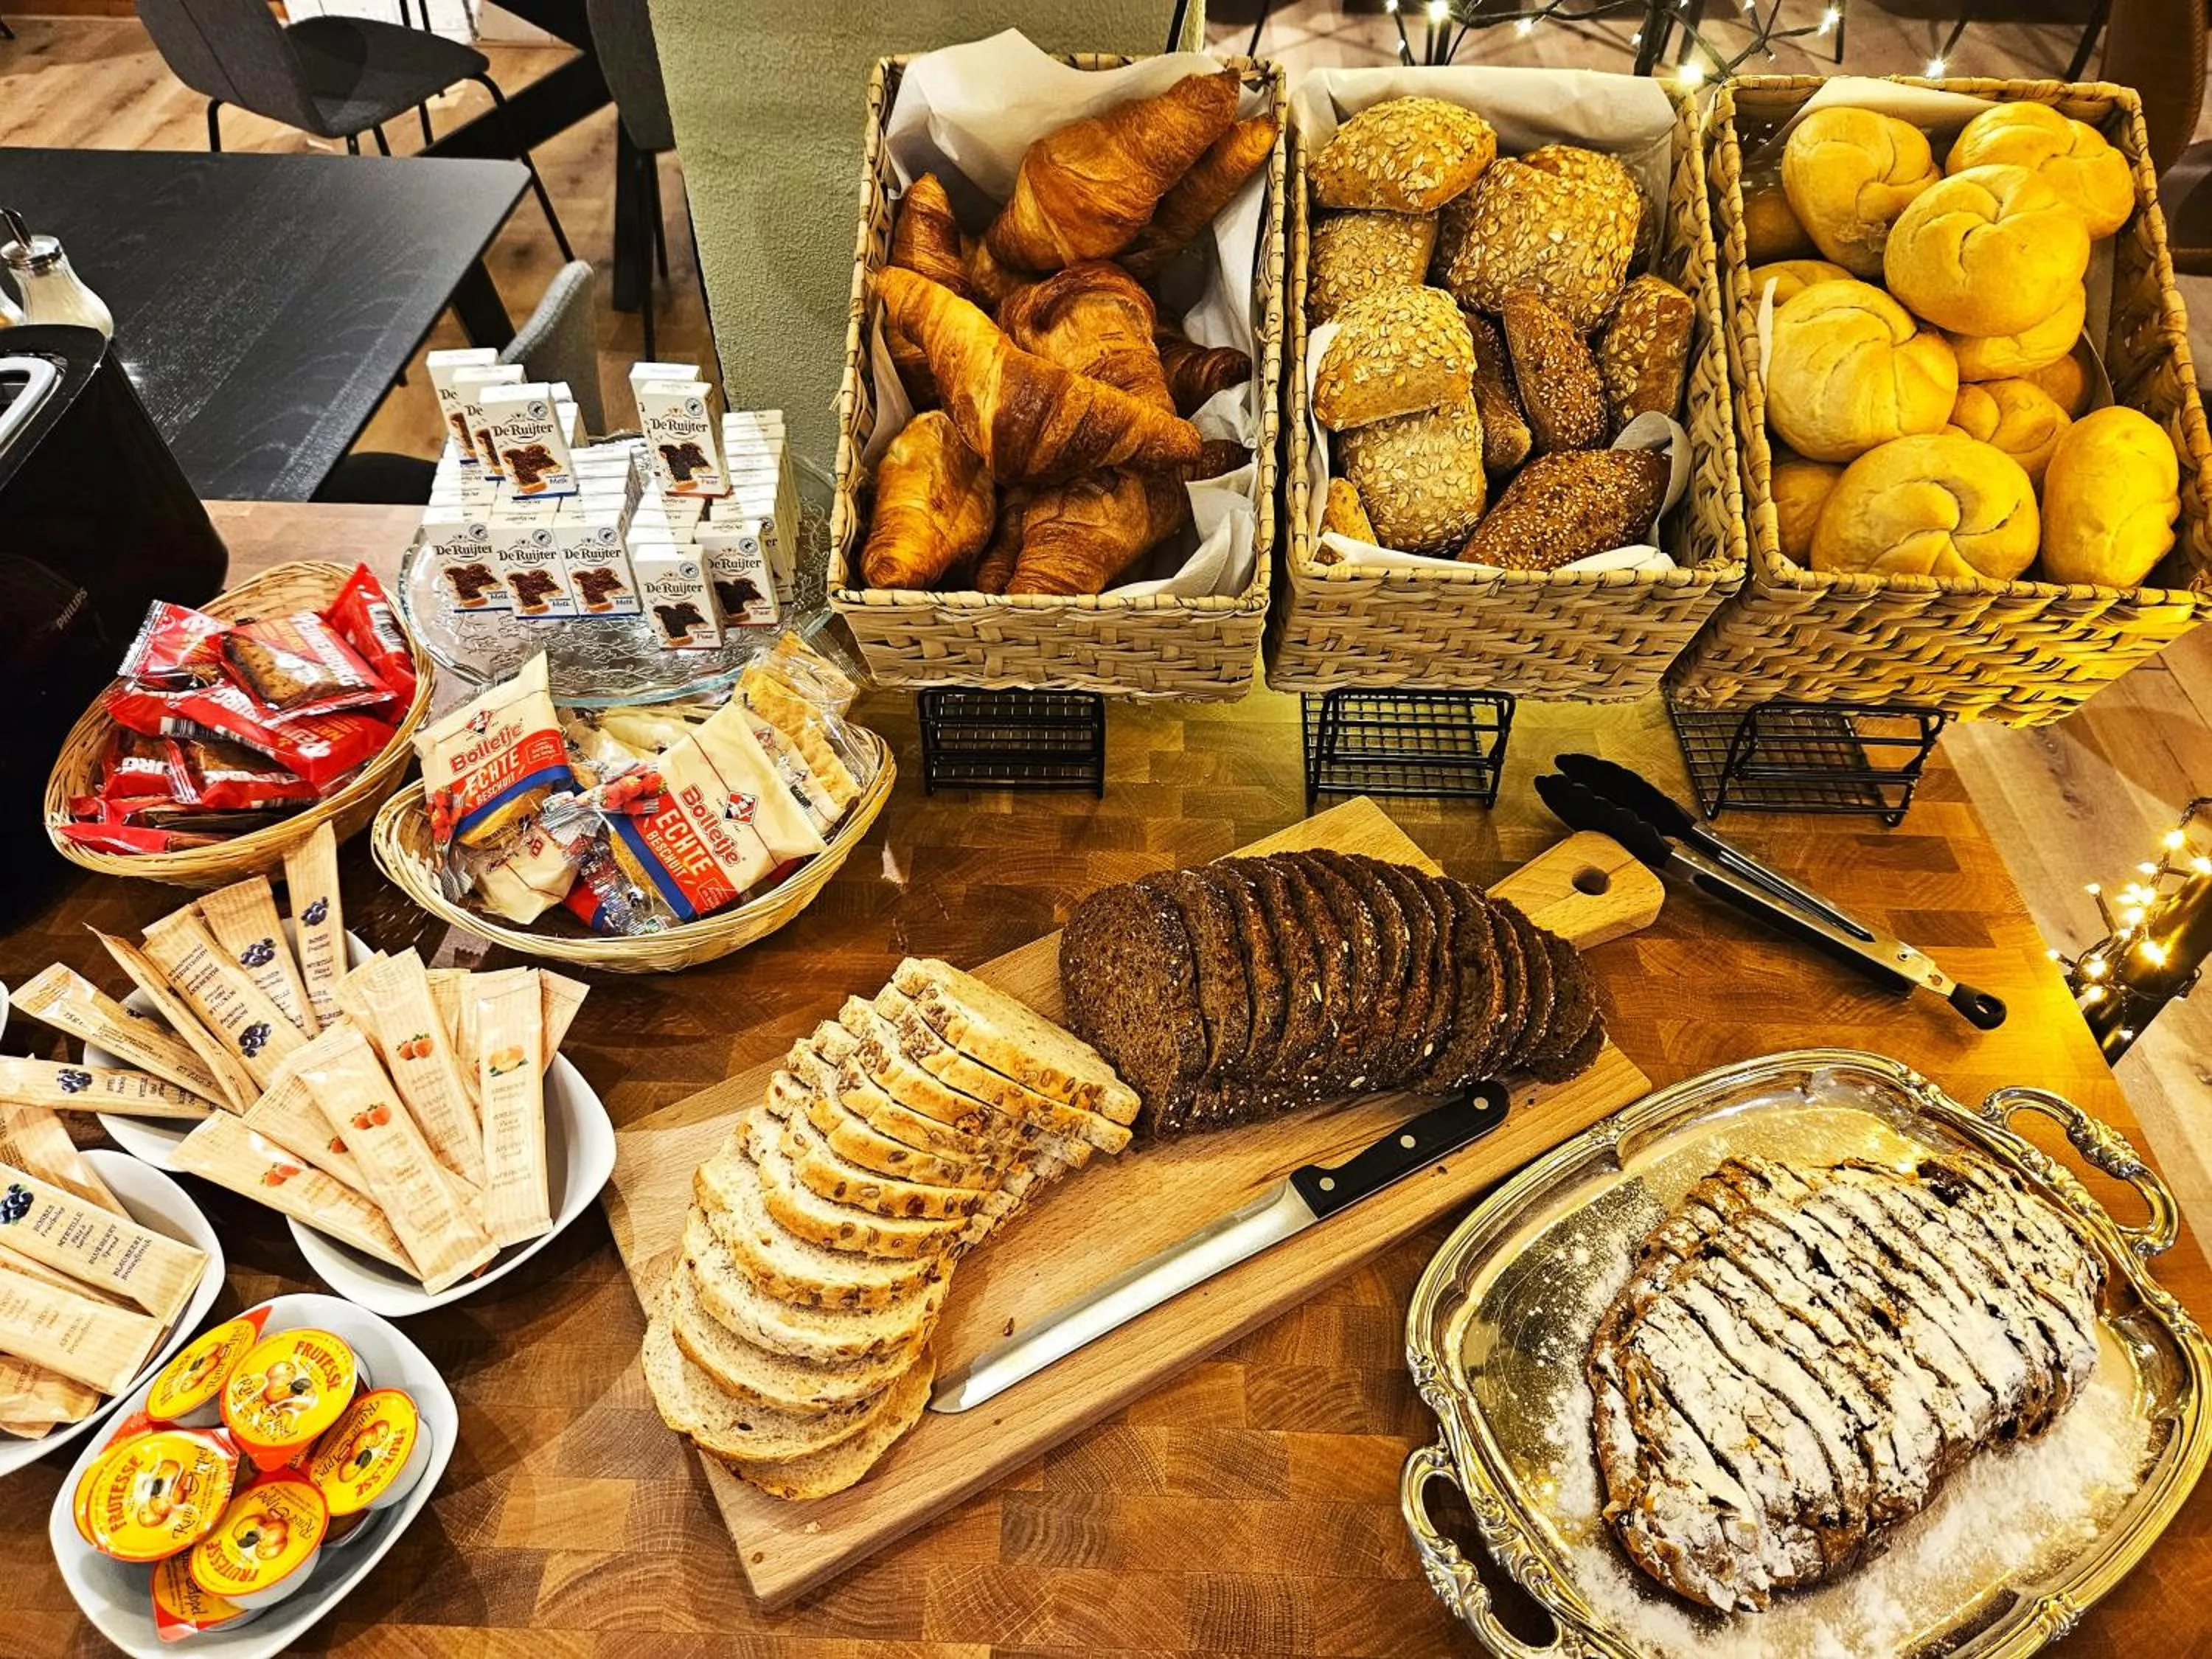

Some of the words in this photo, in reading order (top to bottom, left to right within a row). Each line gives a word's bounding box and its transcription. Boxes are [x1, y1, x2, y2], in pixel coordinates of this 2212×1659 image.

[491, 425, 511, 437] De
[511, 423, 554, 439] Ruijter
[650, 418, 667, 430] De
[668, 418, 708, 434] Ruijter
[434, 545, 451, 554] De
[498, 550, 515, 561] De
[515, 550, 556, 565] Ruijter
[563, 549, 580, 559] De
[581, 548, 622, 563] Ruijter
[722, 558, 762, 572] Ruijter
[56, 588, 88, 629] PHILIPS
[644, 583, 661, 593] De
[663, 583, 703, 597] Ruijter
[450, 723, 524, 774] Bolletje
[466, 747, 519, 794] ECHTE
[476, 772, 516, 804] BESCHUIT
[655, 809, 714, 876] ECHTE
[680, 783, 740, 866] Bolletje
[646, 830, 688, 877] BESCHUIT
[293, 1340, 342, 1392] FRUTESSE
[107, 1455, 144, 1534] FRUTESSE
[206, 1538, 260, 1582] FRUTESSE
